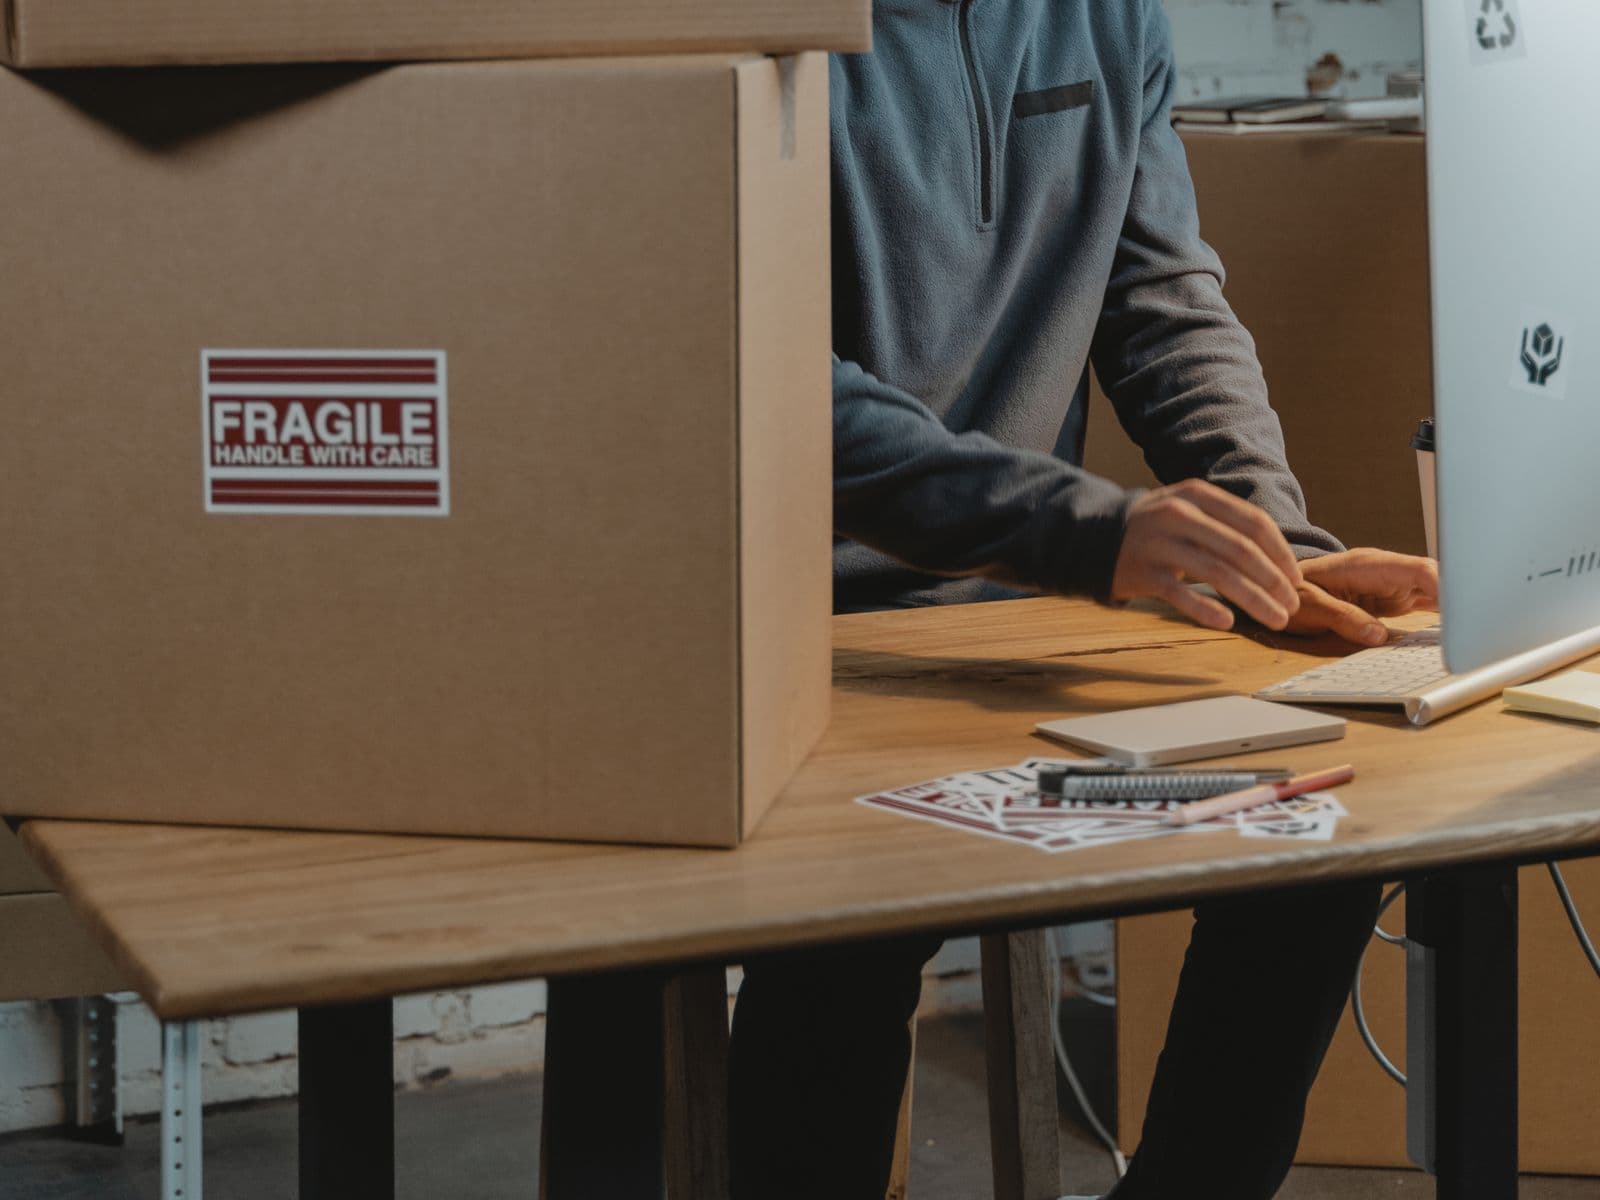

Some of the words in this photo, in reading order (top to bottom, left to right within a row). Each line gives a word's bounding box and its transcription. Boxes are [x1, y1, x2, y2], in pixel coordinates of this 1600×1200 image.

[212, 401, 434, 445] FRAGILE
[214, 445, 304, 465] HANDLE
[309, 445, 366, 466] WITH
[370, 445, 433, 466] CARE
